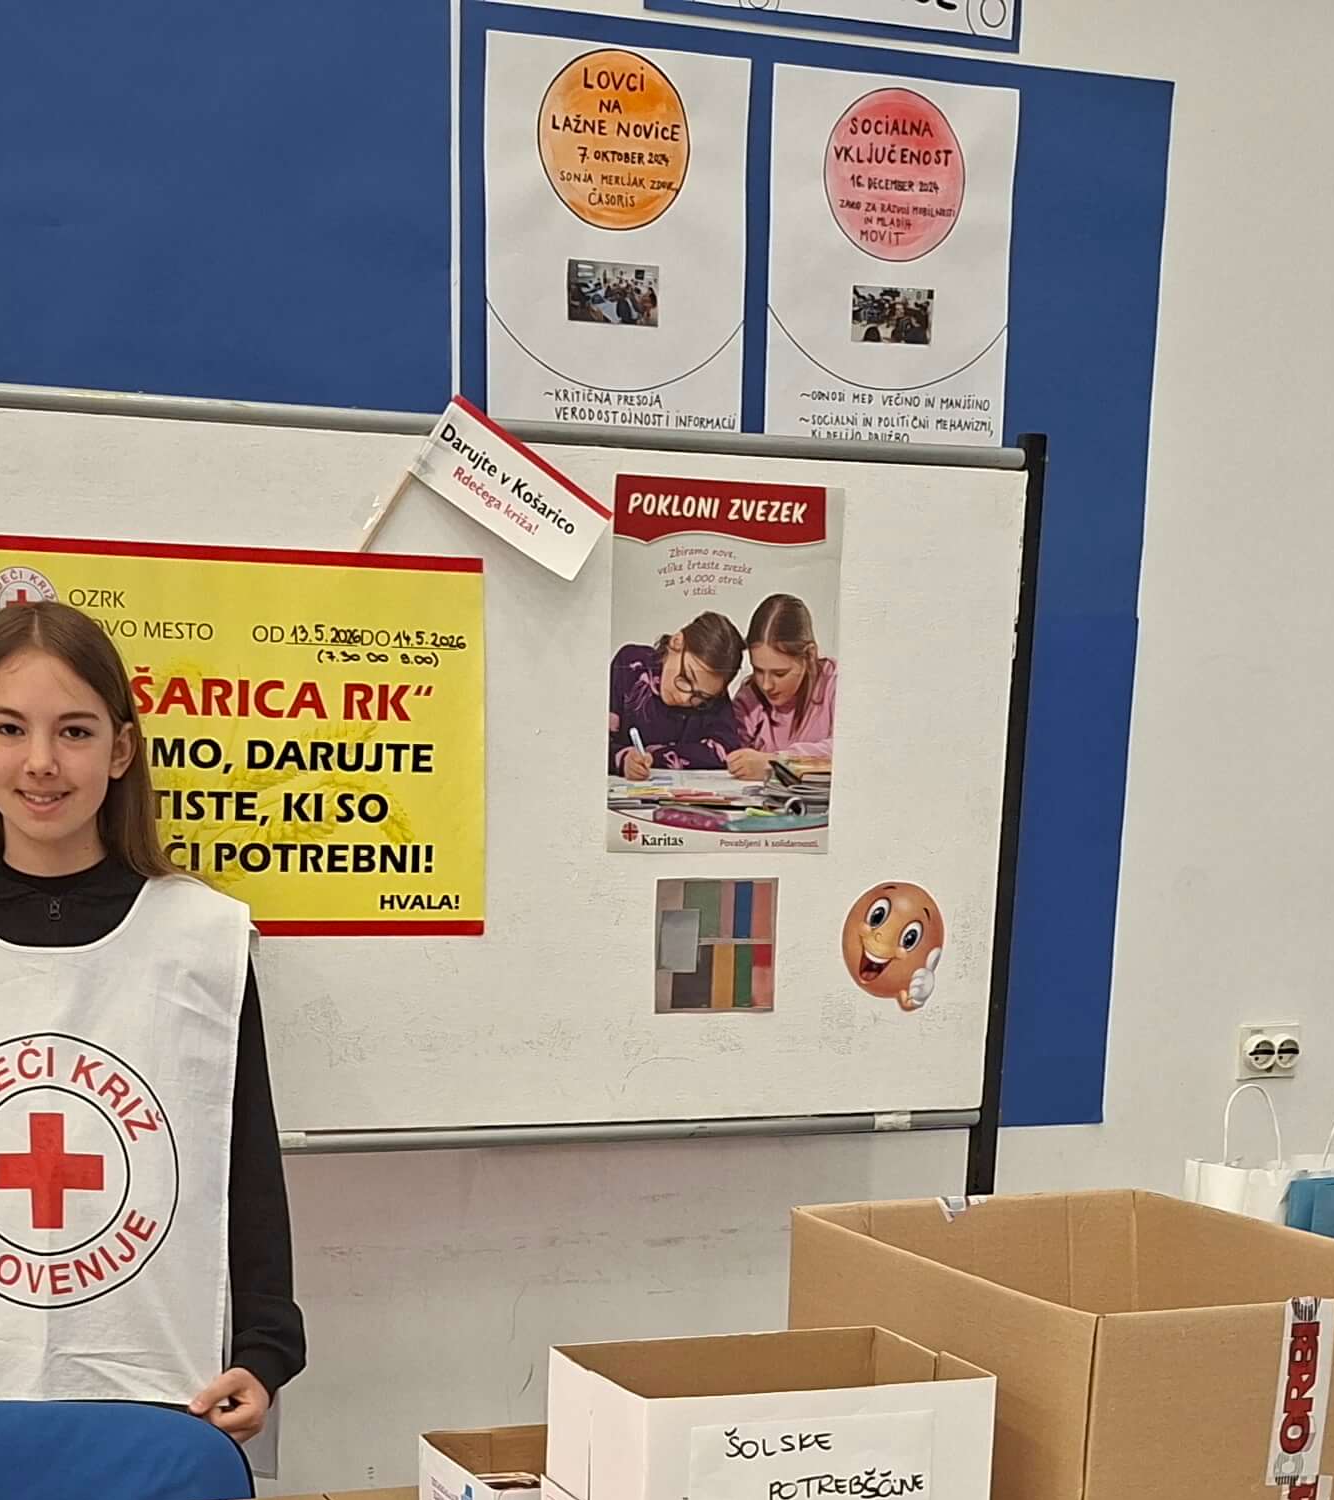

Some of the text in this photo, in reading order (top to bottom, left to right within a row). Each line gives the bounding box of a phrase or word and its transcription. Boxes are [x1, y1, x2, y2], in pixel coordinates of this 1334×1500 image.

[583, 66, 645, 92] LOVCI
[599, 99, 623, 115] NA
[551, 114, 681, 142] LAŽNE NOVICE
[849, 115, 934, 138] SOCIALNA
[577, 147, 670, 167] 7. OKTOBER 2024
[834, 143, 953, 167] VKLJUČENOST
[560, 170, 593, 184] SONJA
[868, 177, 915, 193] DECEMBER
[588, 187, 636, 208] ČASORIS
[860, 226, 905, 246] MOVIT
[617, 391, 663, 409] PRESOJA
[852, 392, 991, 412] MED VEČINO IN MANJŠINO
[862, 413, 930, 429] IN POLITIČNI
[440, 423, 575, 535] Darujte v Košarico
[453, 466, 540, 536] Rdečega križa!
[628, 492, 808, 524] POKLONI ZVEZEK
[668, 546, 709, 558] Zbiramo
[718, 575, 744, 586] otrok
[68, 589, 125, 609] OZRK
[143, 621, 214, 641] MESTO
[252, 625, 284, 642] OD
[290, 623, 361, 645] 13.5.2026
[361, 629, 390, 646] DO
[394, 630, 467, 650] 14.5.2026
[130, 666, 328, 719] ŠARICA
[246, 740, 434, 773] DARUJTE
[283, 792, 324, 823] KI
[335, 793, 389, 822] SO
[641, 833, 684, 846] Karitas
[214, 842, 433, 874] POTREBNI!
[379, 894, 459, 911] HVALA!
[70, 1054, 164, 1142] KRIŽ
[724, 1427, 833, 1459] ŠOLSKE
